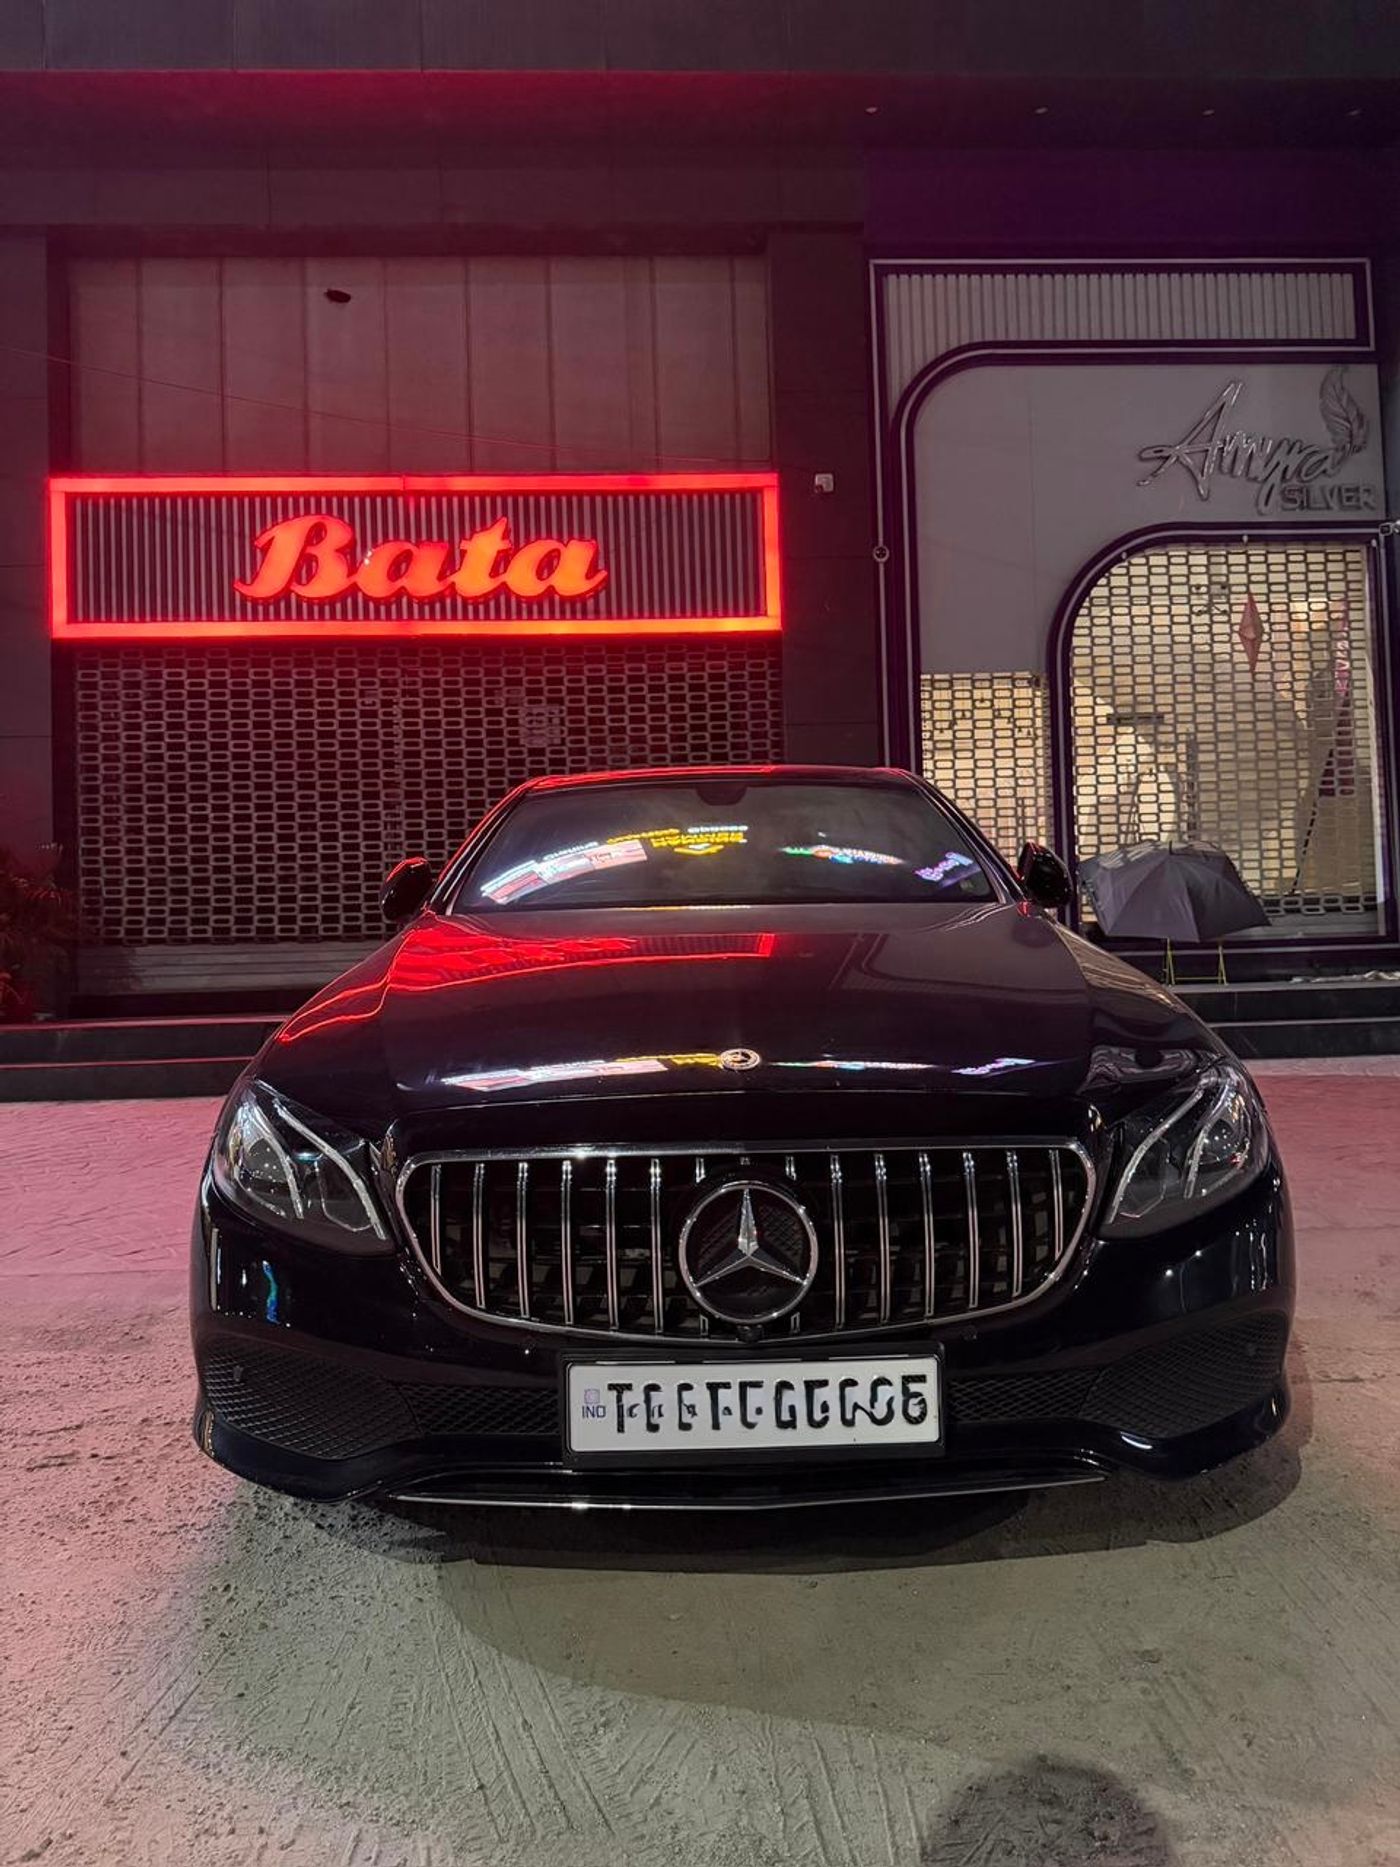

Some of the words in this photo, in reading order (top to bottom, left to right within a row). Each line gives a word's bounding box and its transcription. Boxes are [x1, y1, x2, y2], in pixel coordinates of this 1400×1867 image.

[1281, 484, 1377, 511] SILVER
[233, 513, 608, 600] Bata
[581, 1404, 607, 1419] IND
